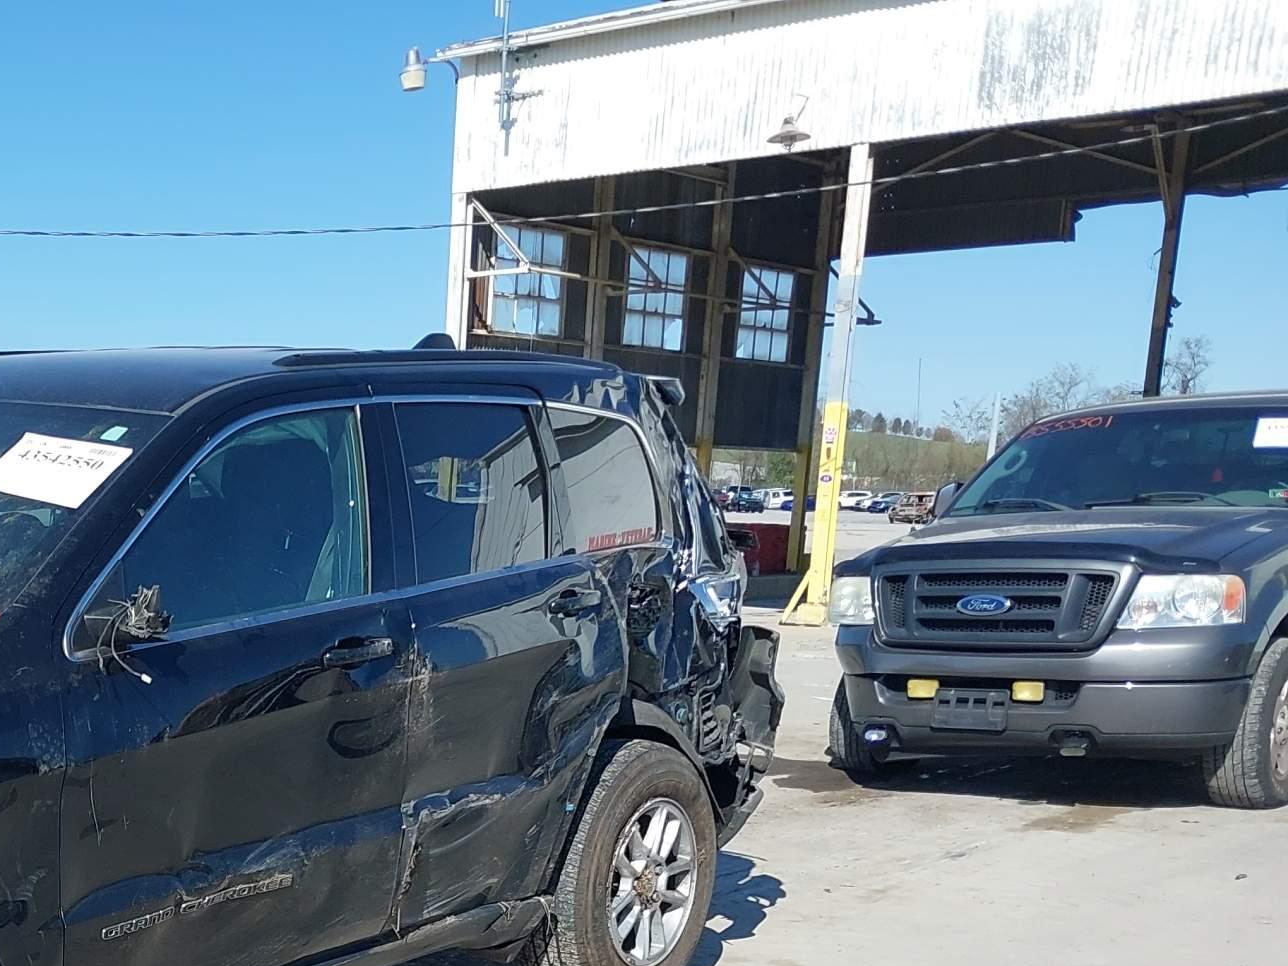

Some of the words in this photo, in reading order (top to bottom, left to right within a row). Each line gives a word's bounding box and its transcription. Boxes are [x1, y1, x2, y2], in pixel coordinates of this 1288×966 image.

[18, 449, 105, 470] 43542550
[967, 598, 998, 610] Ford
[101, 906, 176, 941] GRAND
[180, 873, 294, 914] CHEROKEE
